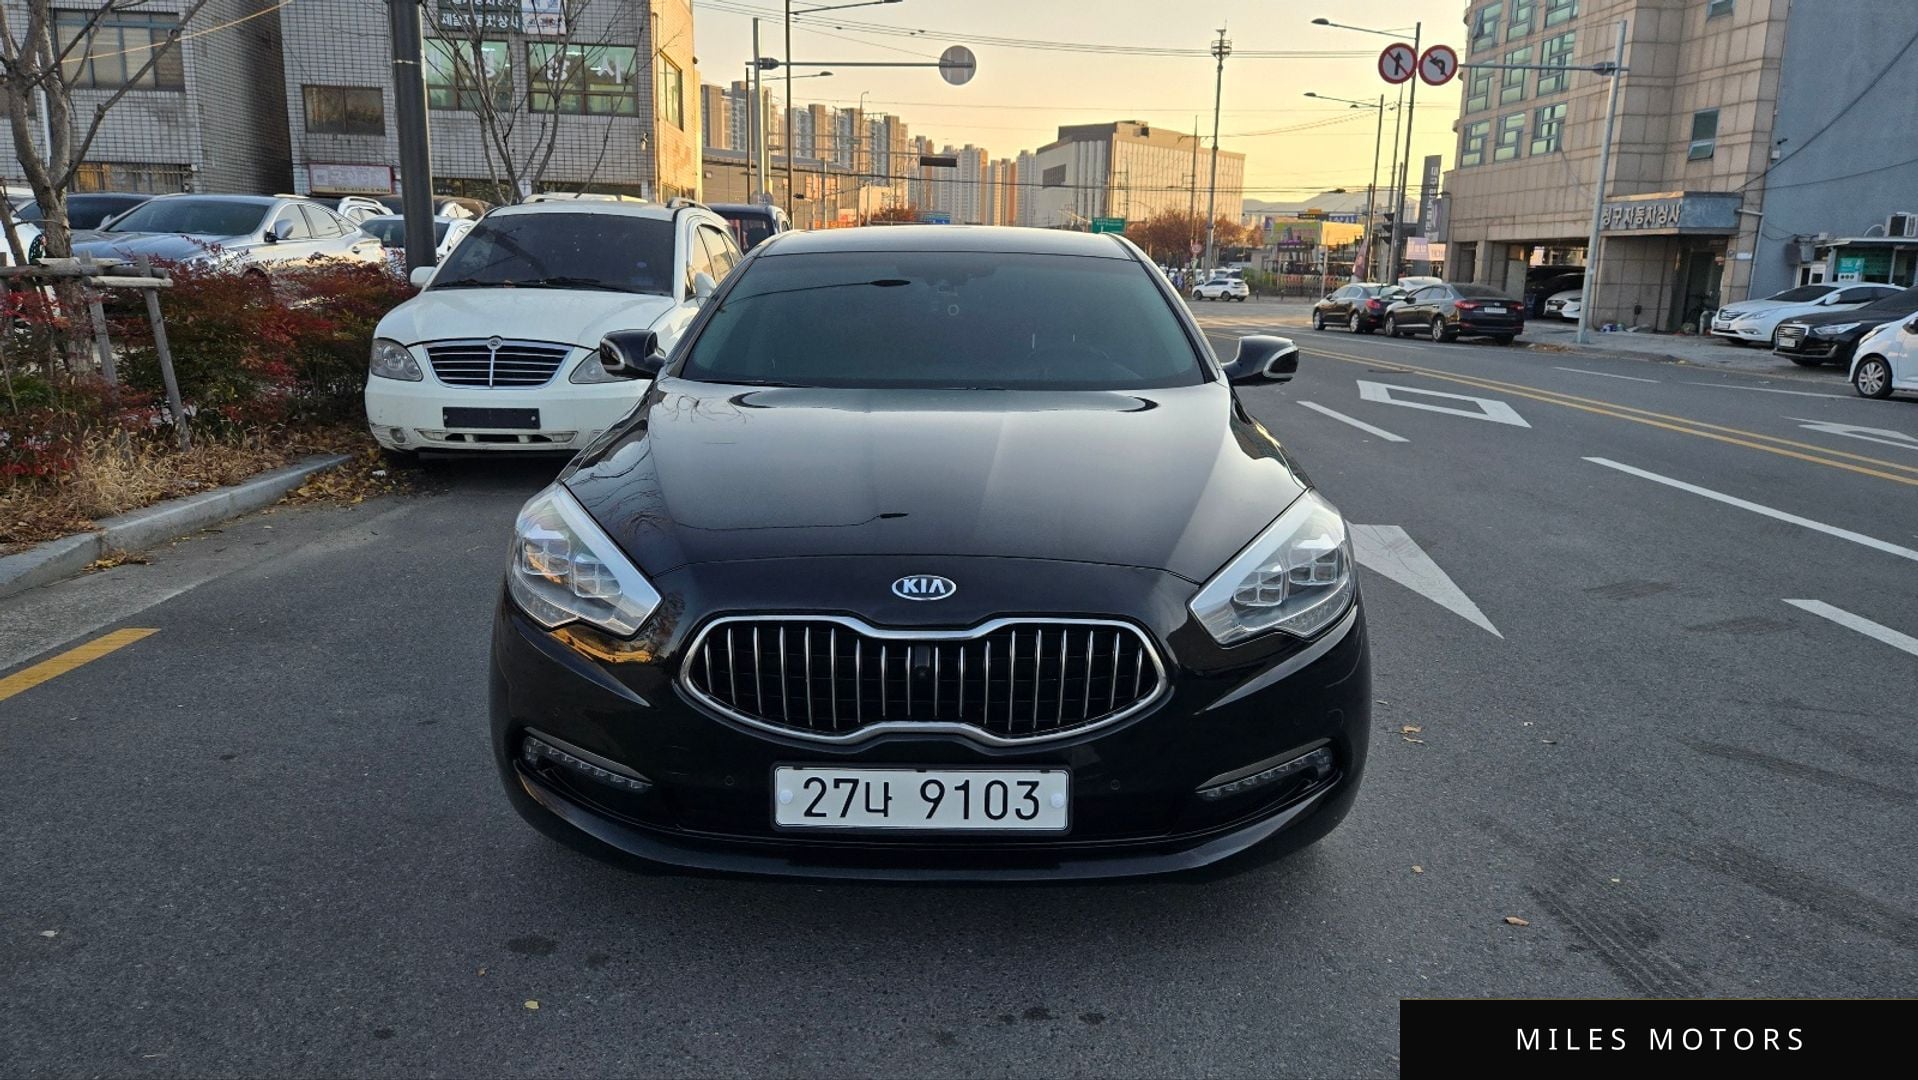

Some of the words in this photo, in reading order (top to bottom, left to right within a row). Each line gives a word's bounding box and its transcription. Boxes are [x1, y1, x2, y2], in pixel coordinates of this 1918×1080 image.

[902, 578, 946, 594] KIA
[803, 776, 893, 818] 27나
[919, 778, 1041, 821] 9103
